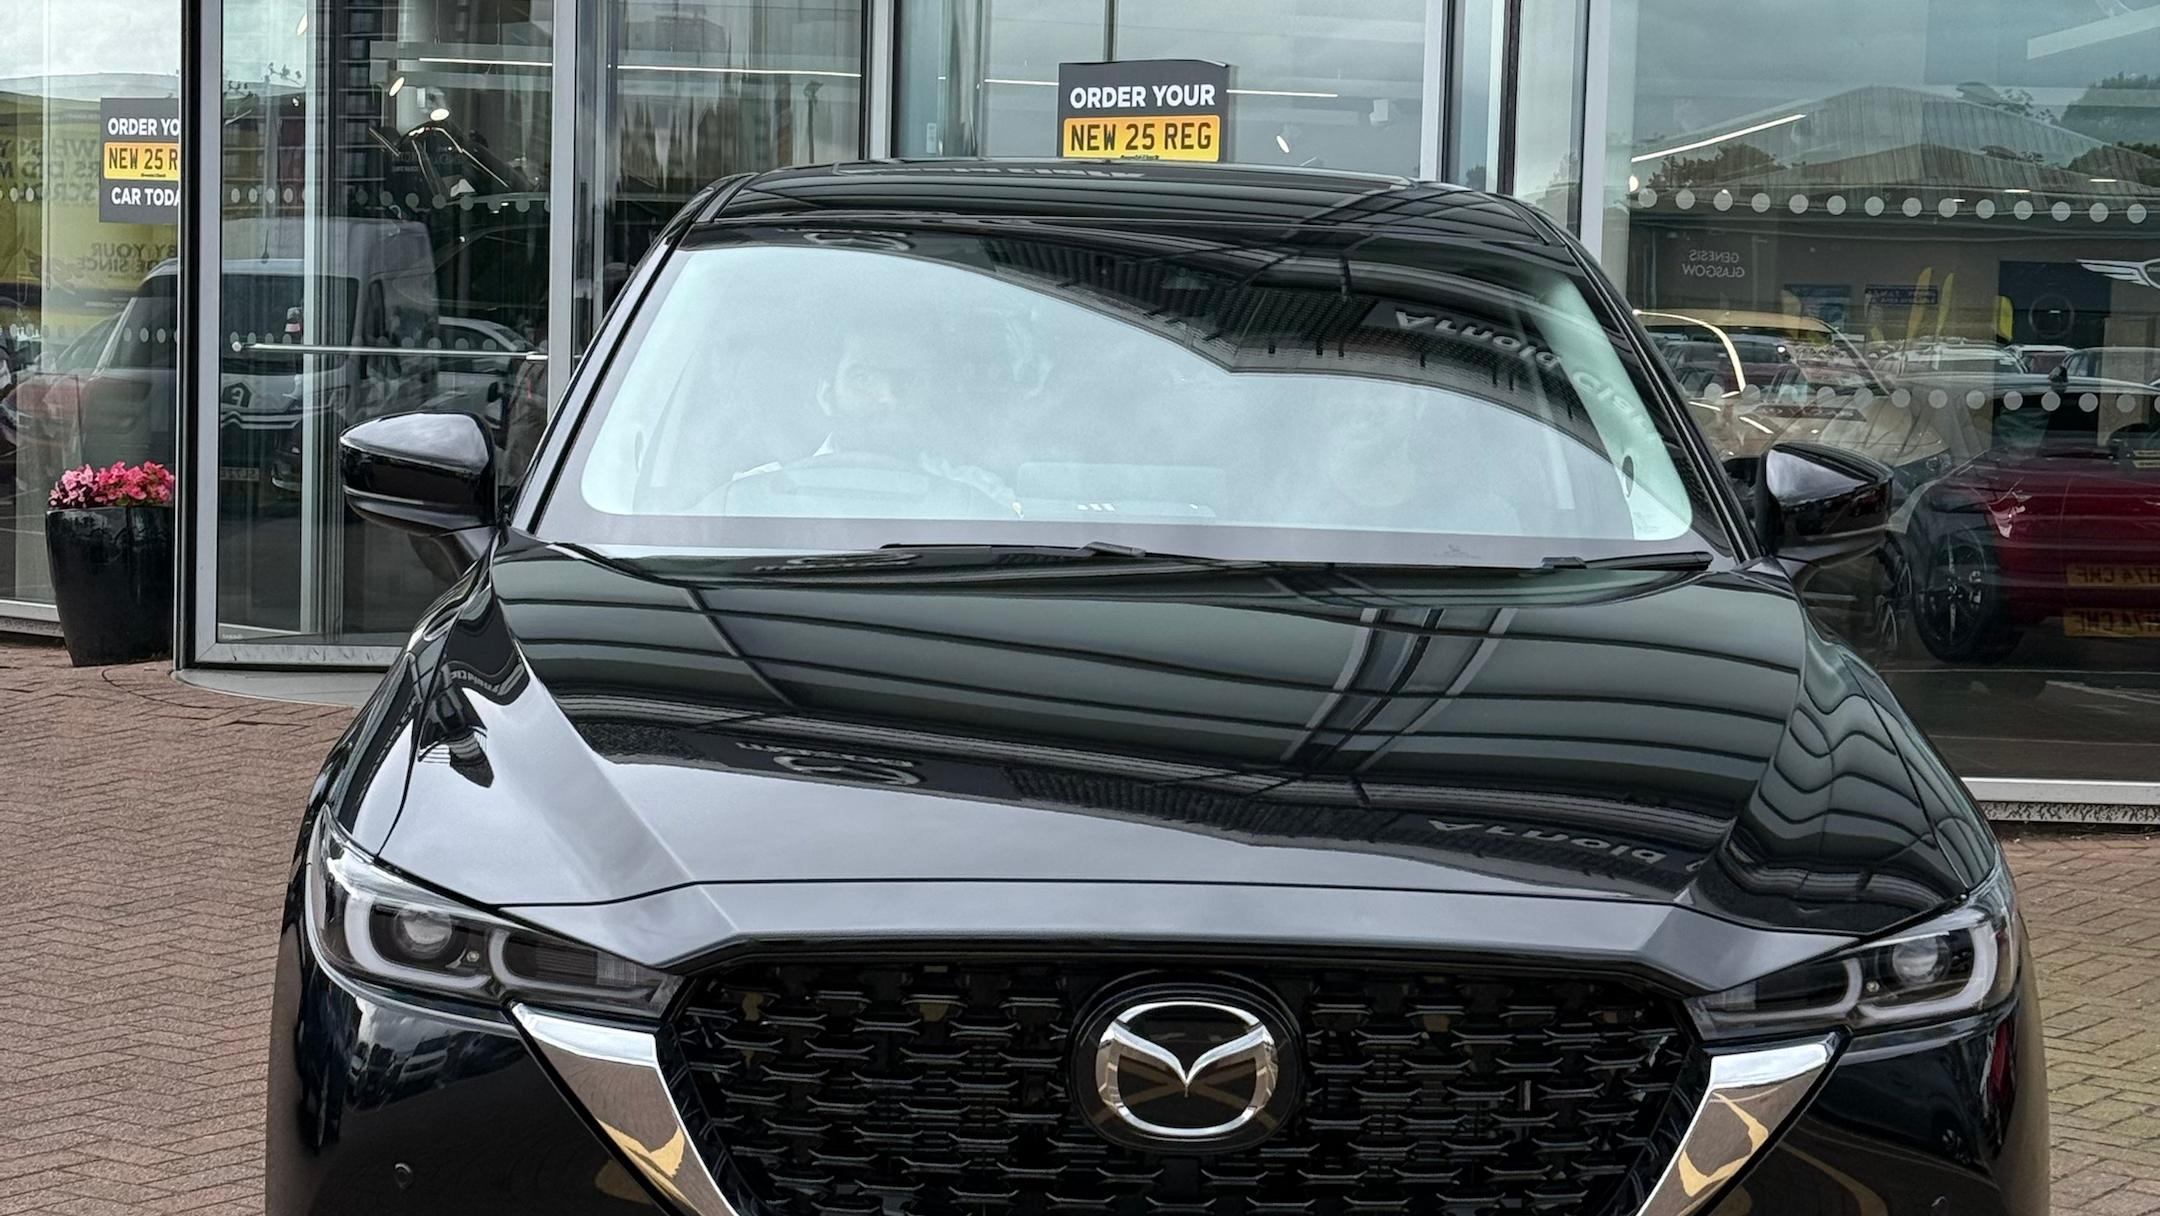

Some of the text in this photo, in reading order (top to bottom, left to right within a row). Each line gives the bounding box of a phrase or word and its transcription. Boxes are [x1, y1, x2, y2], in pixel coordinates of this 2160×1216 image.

[1070, 84, 1215, 108] ORDER YOUR
[108, 118, 157, 136] ORDER
[1071, 122, 1211, 151] NEW 25 REG
[109, 147, 138, 170] NEW
[144, 148, 163, 170] 25
[168, 148, 178, 171] R
[111, 186, 141, 205] CAR
